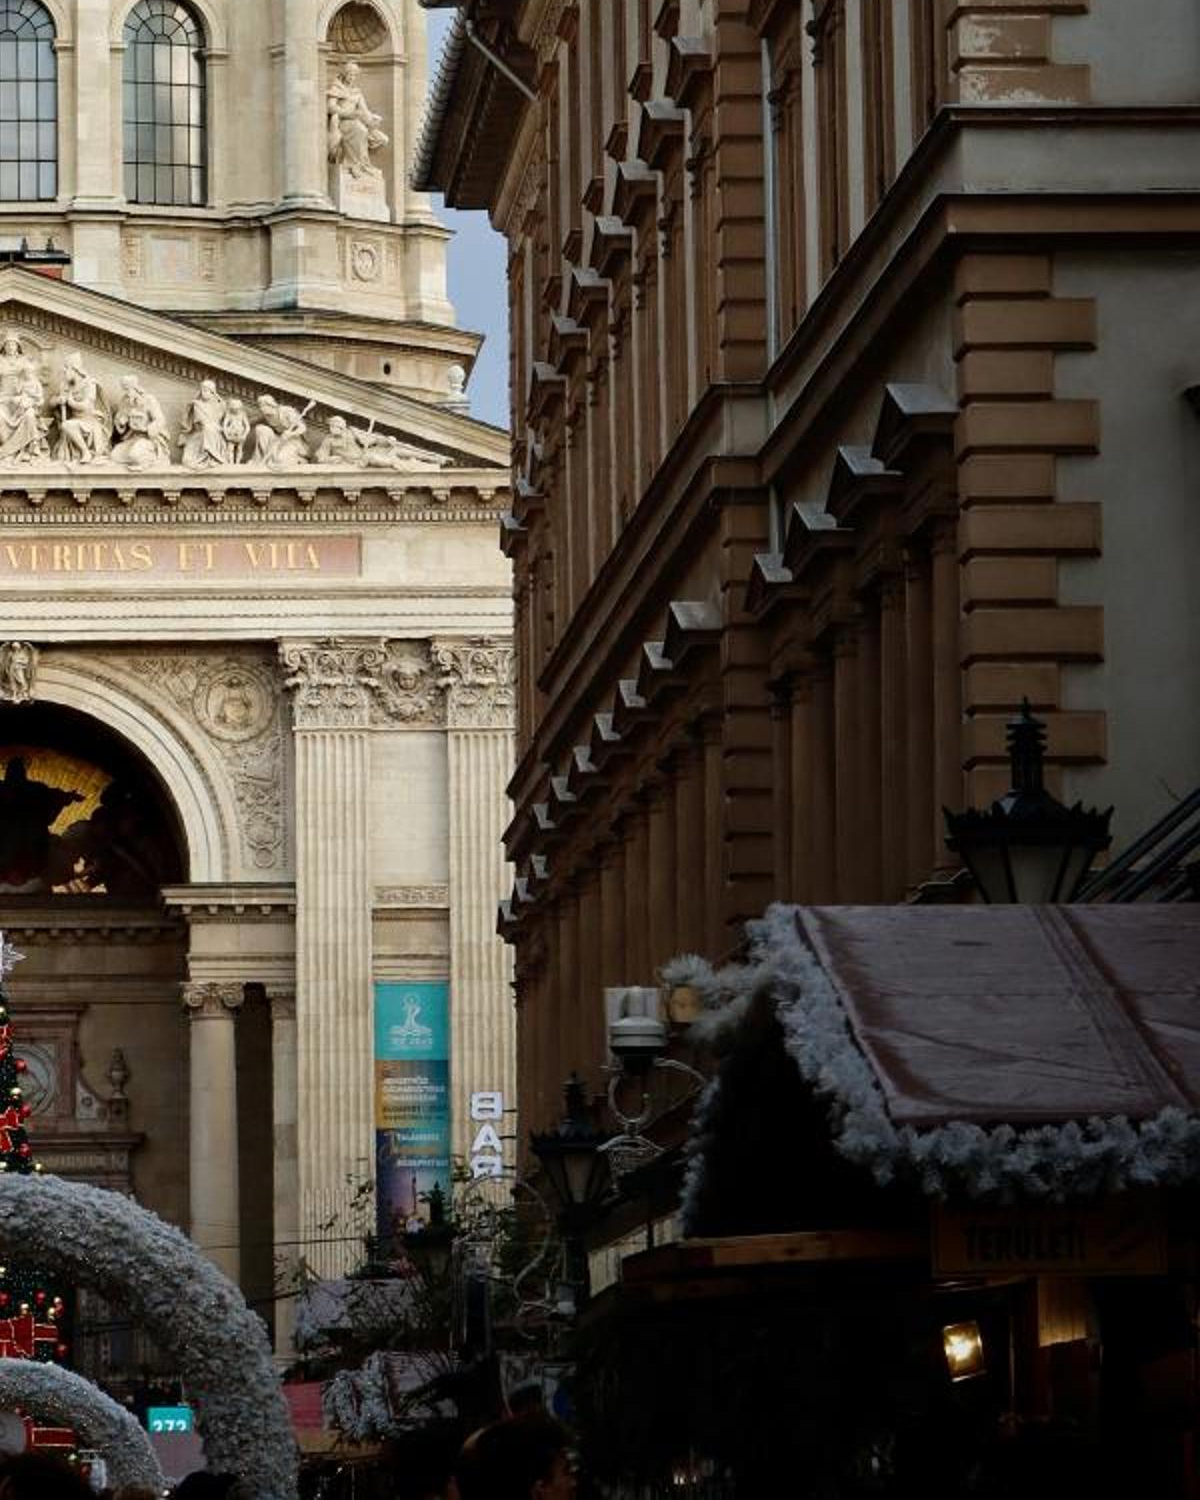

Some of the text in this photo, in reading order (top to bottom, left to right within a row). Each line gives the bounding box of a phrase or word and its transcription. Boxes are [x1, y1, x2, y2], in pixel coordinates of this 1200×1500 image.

[5, 543, 155, 571] VERITAS
[177, 543, 220, 570] ET
[245, 542, 321, 570] VITA
